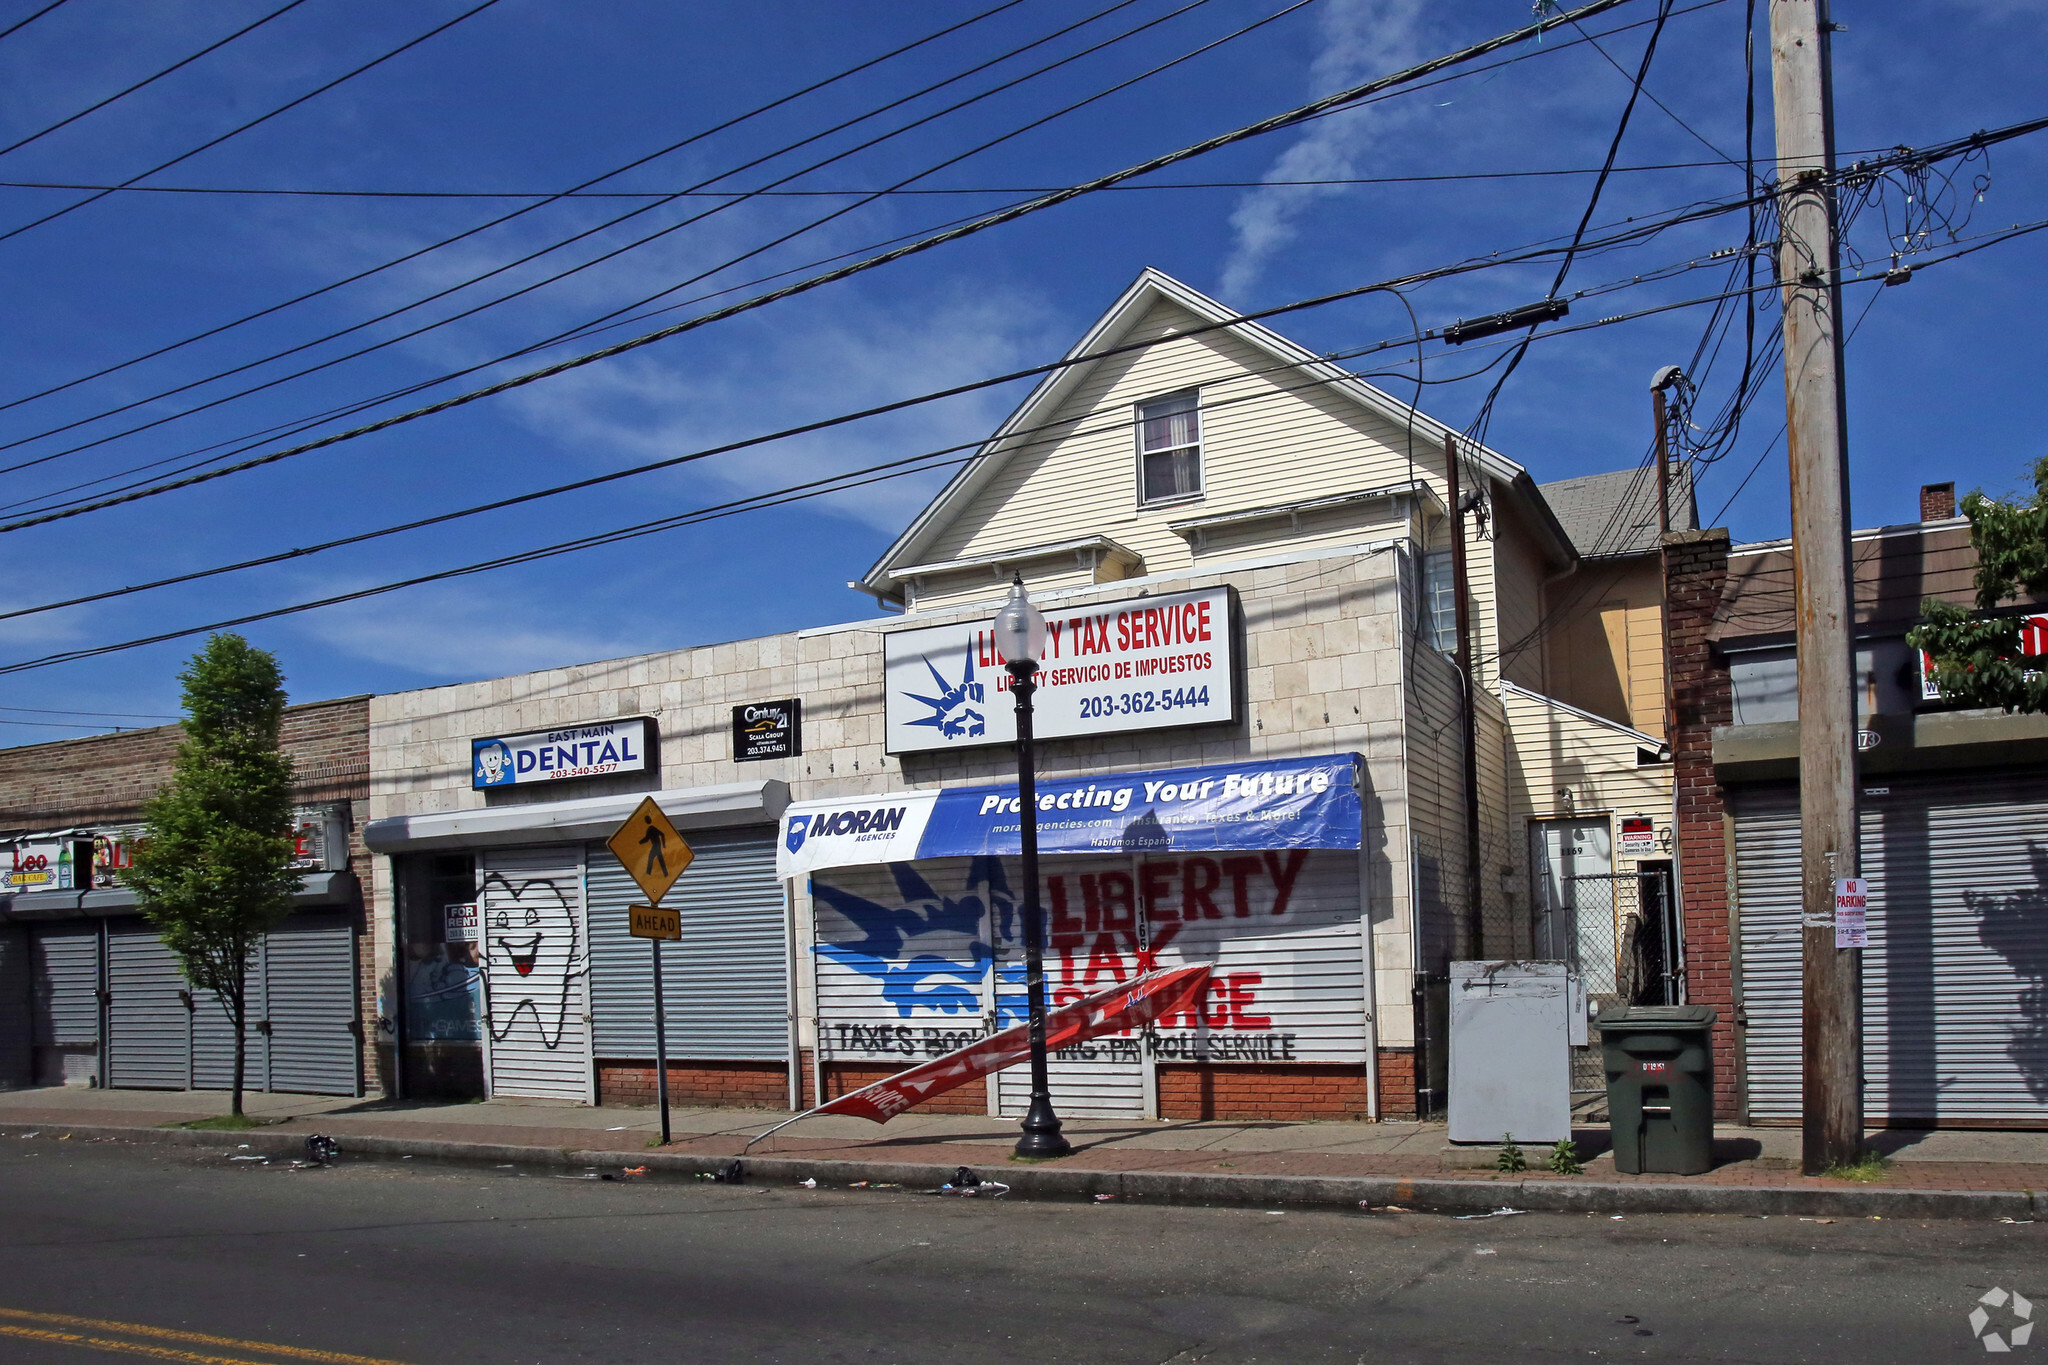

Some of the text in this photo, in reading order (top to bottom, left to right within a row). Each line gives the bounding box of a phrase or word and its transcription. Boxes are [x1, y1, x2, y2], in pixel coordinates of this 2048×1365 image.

[1069, 613, 1112, 657] TAX
[1117, 601, 1212, 652] SERVICE
[1051, 664, 1111, 687] SERVICIO
[1114, 661, 1132, 680] DE
[1135, 651, 1212, 677] IMPUESTOS
[1079, 685, 1210, 719] 203-362-5444
[744, 706, 788, 729] Century 21
[548, 725, 614, 743] EAST MAIN
[516, 737, 638, 774] DENTAL
[549, 763, 618, 779] 203-540-5577
[1143, 780, 1216, 804] Your
[1221, 770, 1330, 798] Future
[809, 807, 907, 838] MORAN
[992, 818, 1113, 833] moragencies.com
[1204, 811, 1241, 823] Taxes
[854, 832, 897, 843] AGENCIES
[1091, 835, 1175, 848] Hablamos Español
[12, 849, 49, 871] Leo
[1561, 847, 1583, 856] 1169
[1047, 850, 1310, 934] LIBERTY
[1846, 880, 1857, 893] NO
[451, 907, 474, 917] FOR
[1836, 895, 1866, 908] PARKING
[448, 916, 478, 927] RENT
[636, 914, 675, 932] AHEAD
[1137, 895, 1148, 952] 1165
[1050, 922, 1184, 986] TAX
[835, 1023, 916, 1057] TAXES
[1207, 1033, 1297, 1061] SERVICE
